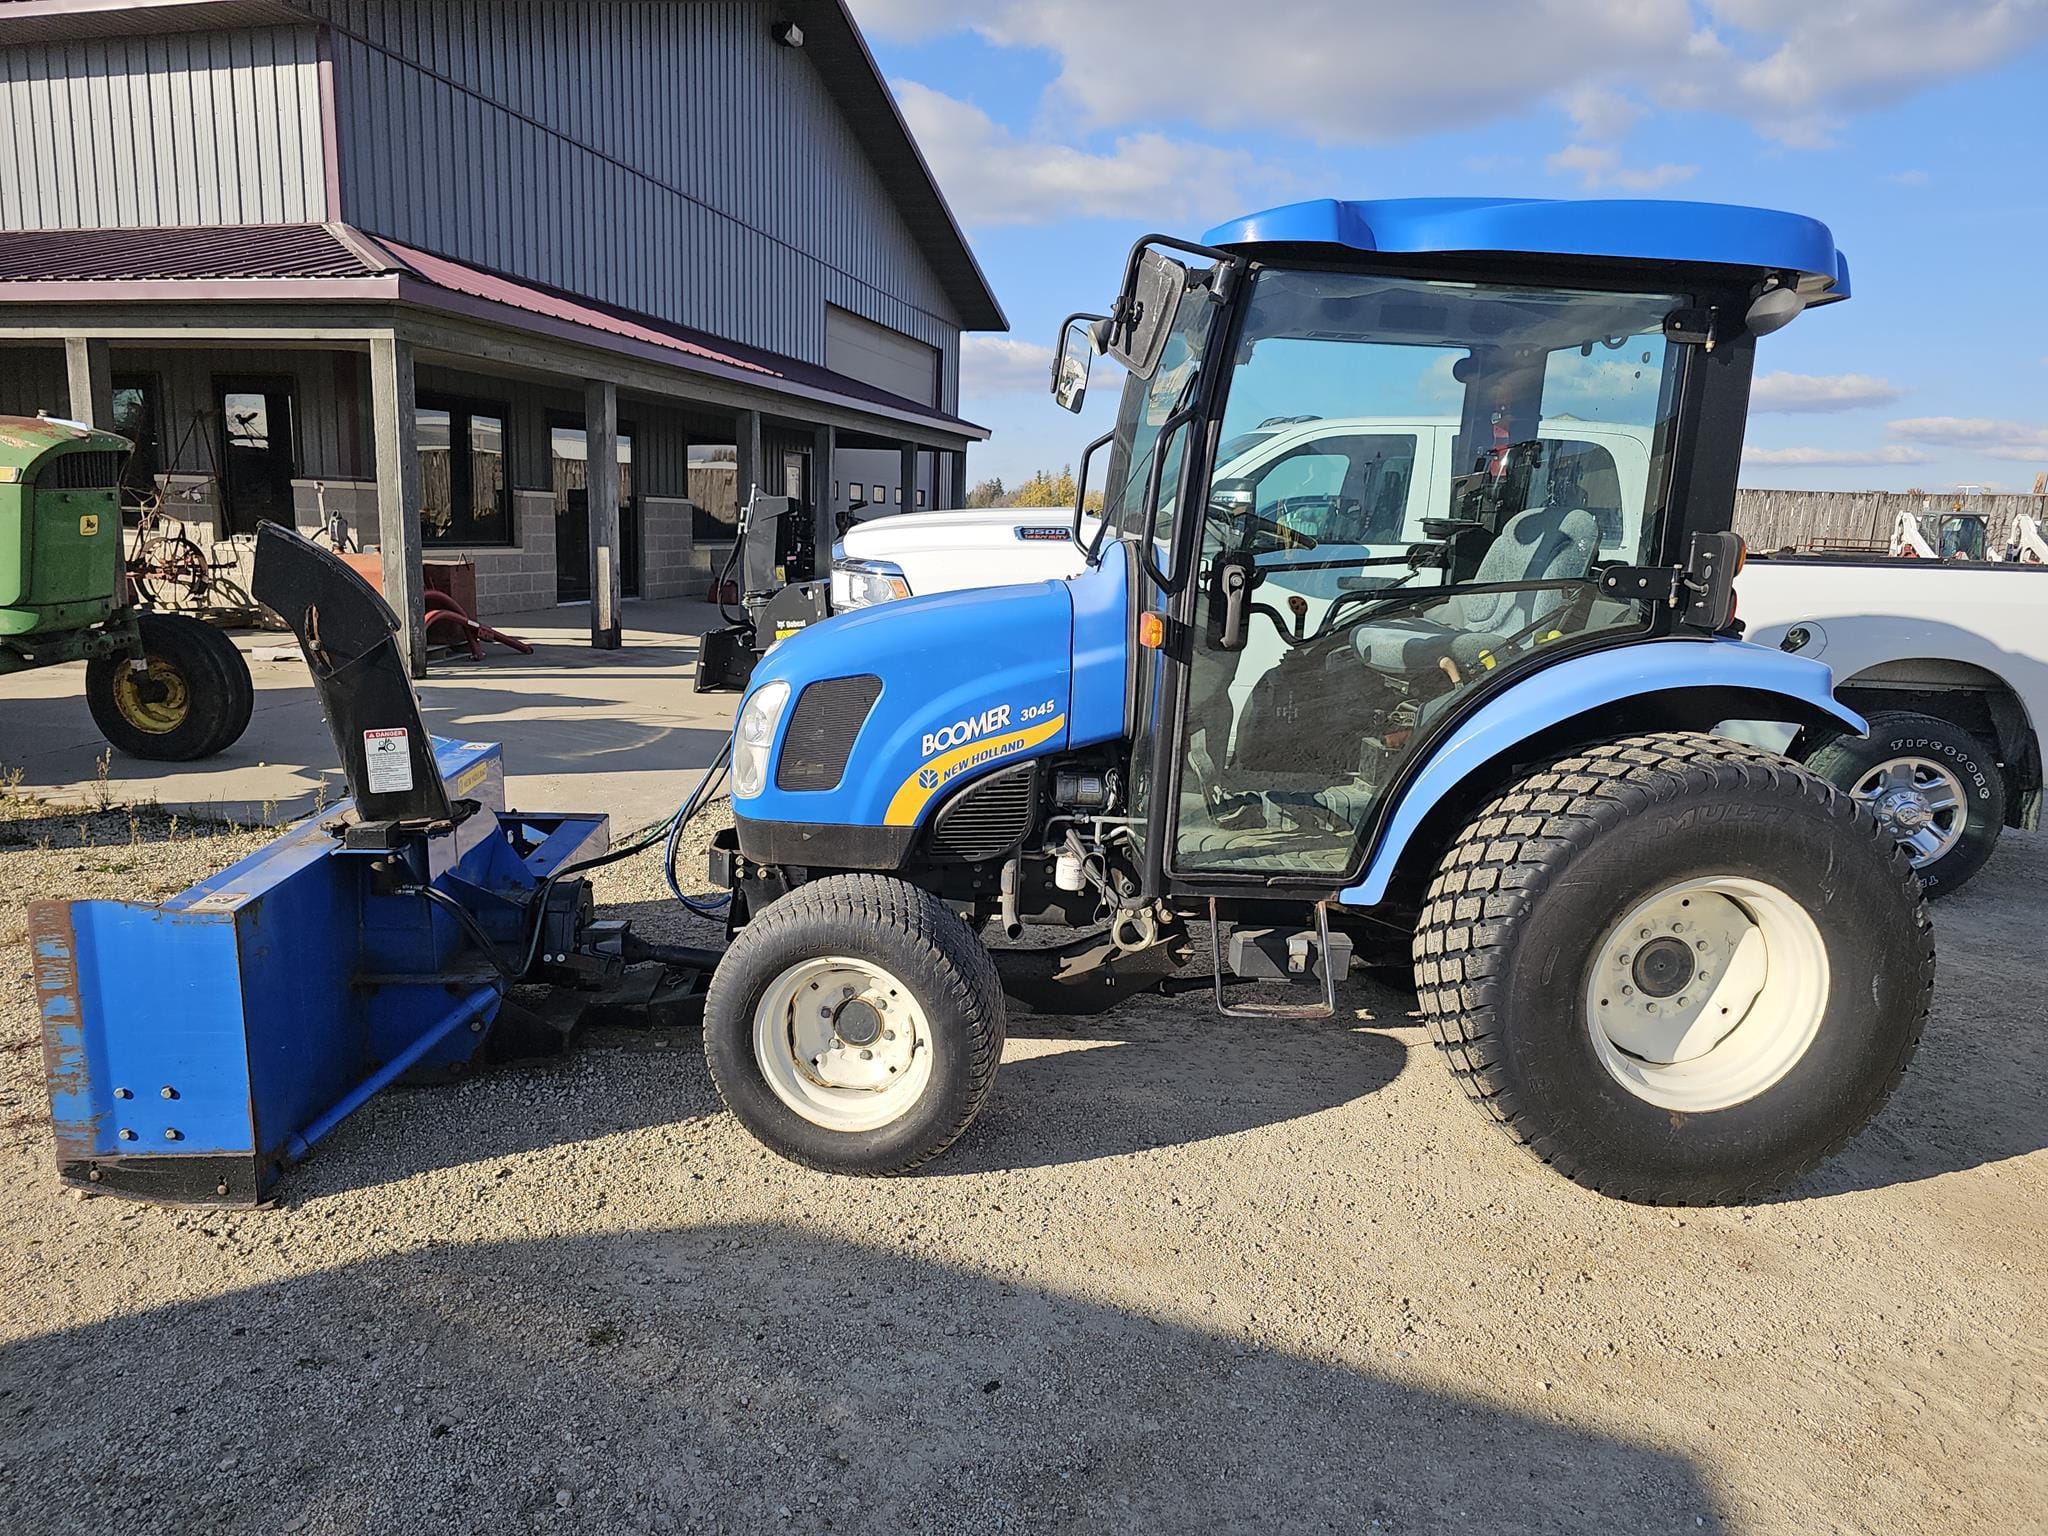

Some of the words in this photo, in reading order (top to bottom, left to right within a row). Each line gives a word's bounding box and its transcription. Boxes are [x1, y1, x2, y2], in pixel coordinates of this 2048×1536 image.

[375, 730, 403, 738] DANGER
[922, 704, 1012, 758] BOOMER
[1020, 699, 1055, 722] 3045
[943, 757, 969, 782] NEW
[971, 738, 1025, 765] HOLLAND
